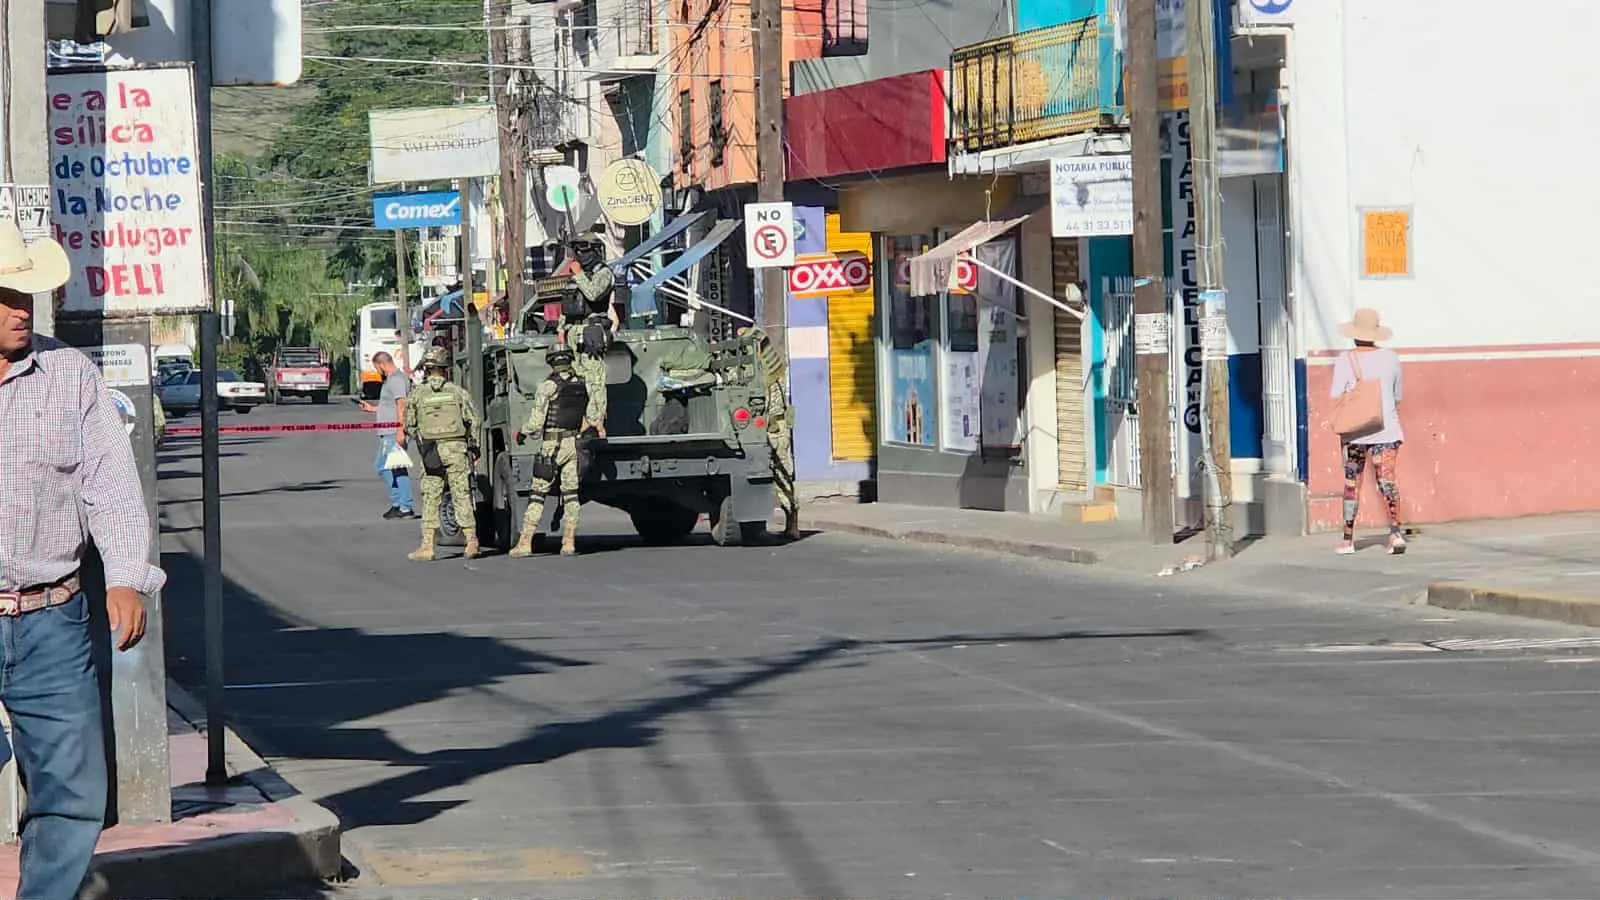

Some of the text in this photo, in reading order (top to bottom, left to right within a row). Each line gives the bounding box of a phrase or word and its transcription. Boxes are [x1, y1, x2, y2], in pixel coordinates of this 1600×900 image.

[81, 90, 106, 111] a
[118, 82, 152, 109] la
[55, 152, 191, 179] de Octubre
[1056, 162, 1097, 173] NOTARIA
[57, 187, 182, 215] la Noche
[385, 200, 456, 220] Comex
[34, 208, 45, 227] 7
[757, 210, 781, 221] NO
[86, 263, 165, 298] DELI
[791, 260, 868, 289] OXXO
